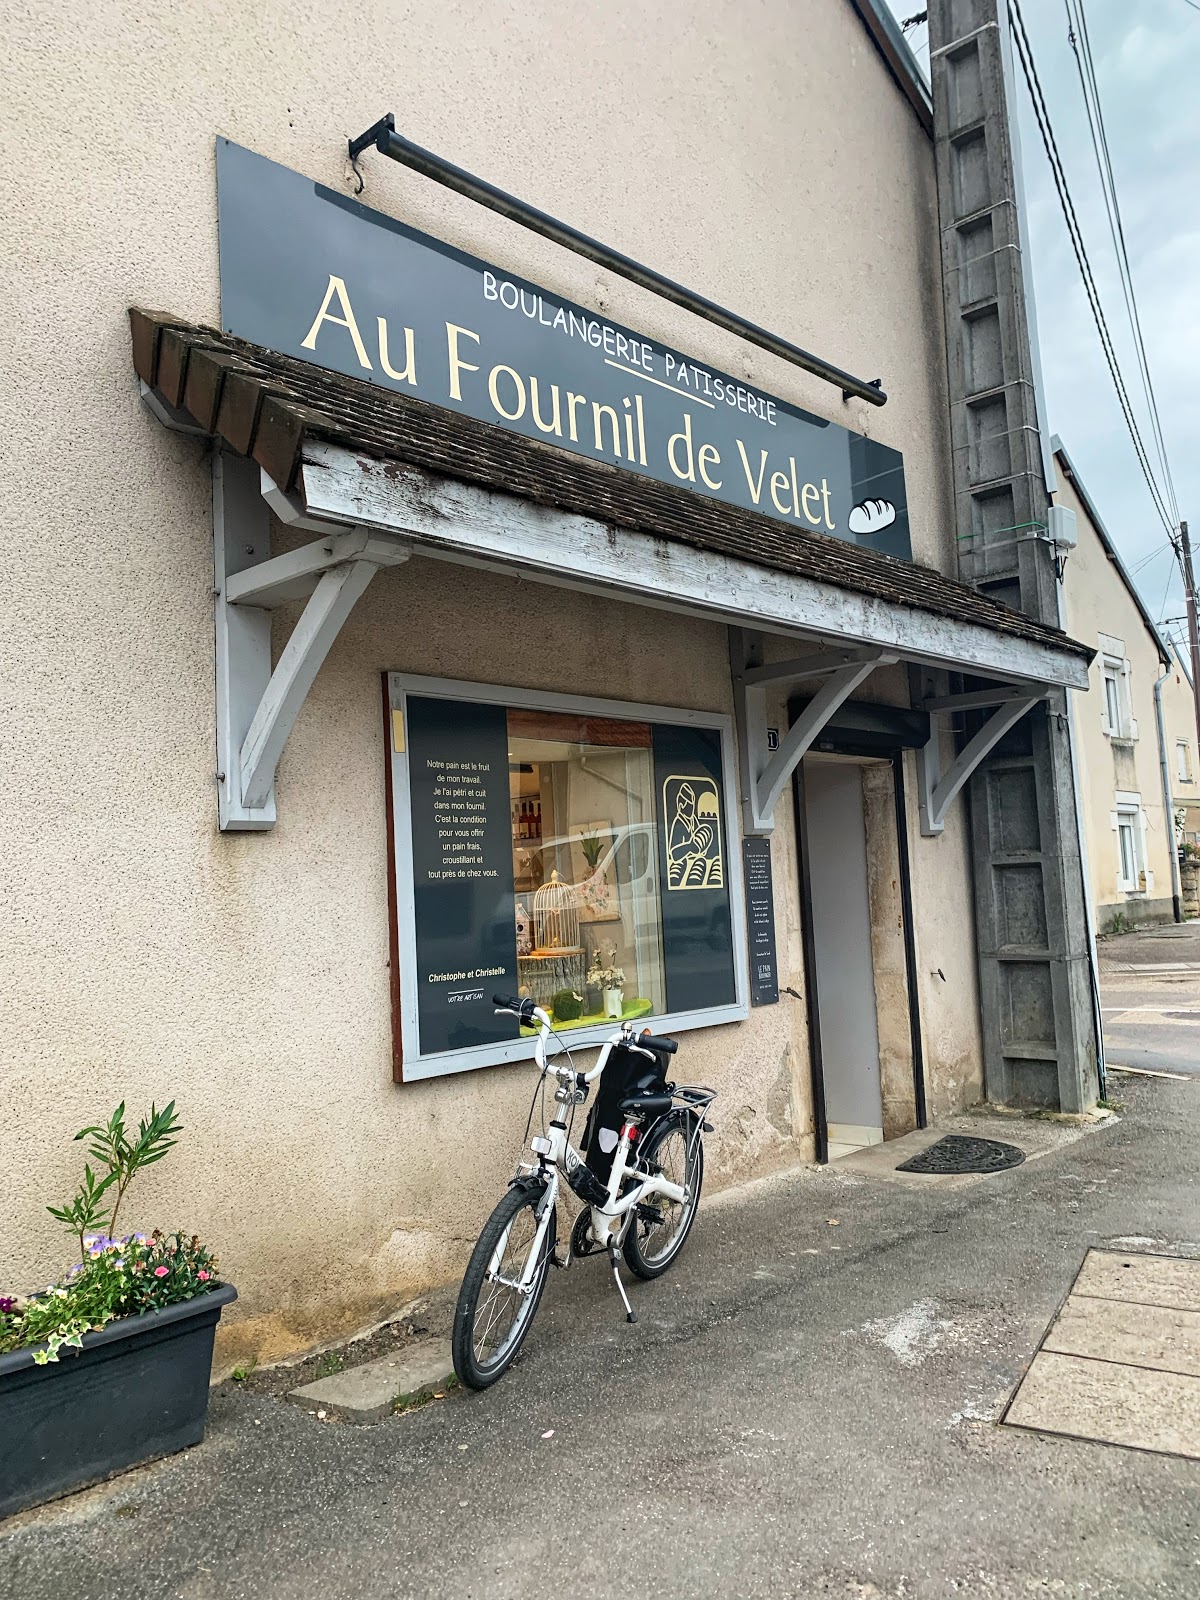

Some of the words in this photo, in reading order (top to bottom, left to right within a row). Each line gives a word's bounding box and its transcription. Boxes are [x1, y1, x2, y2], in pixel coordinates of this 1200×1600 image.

[482, 270, 654, 373] BOULANGERIE
[665, 353, 778, 427] PATISSERIE
[300, 274, 418, 386] Au
[445, 321, 648, 467] Fournil
[667, 413, 723, 490] de
[736, 439, 836, 530] Velet
[427, 760, 444, 768] Notre
[446, 762, 459, 770] pain
[453, 789, 466, 798] pétri
[434, 801, 450, 809] dans
[466, 802, 486, 810] fournil.
[453, 842, 466, 852] pain
[467, 842, 481, 851] frais,
[443, 870, 456, 880] près
[429, 972, 466, 983] Christophe
[476, 967, 505, 978] Christelle
[448, 996, 464, 1004] VOTRE
